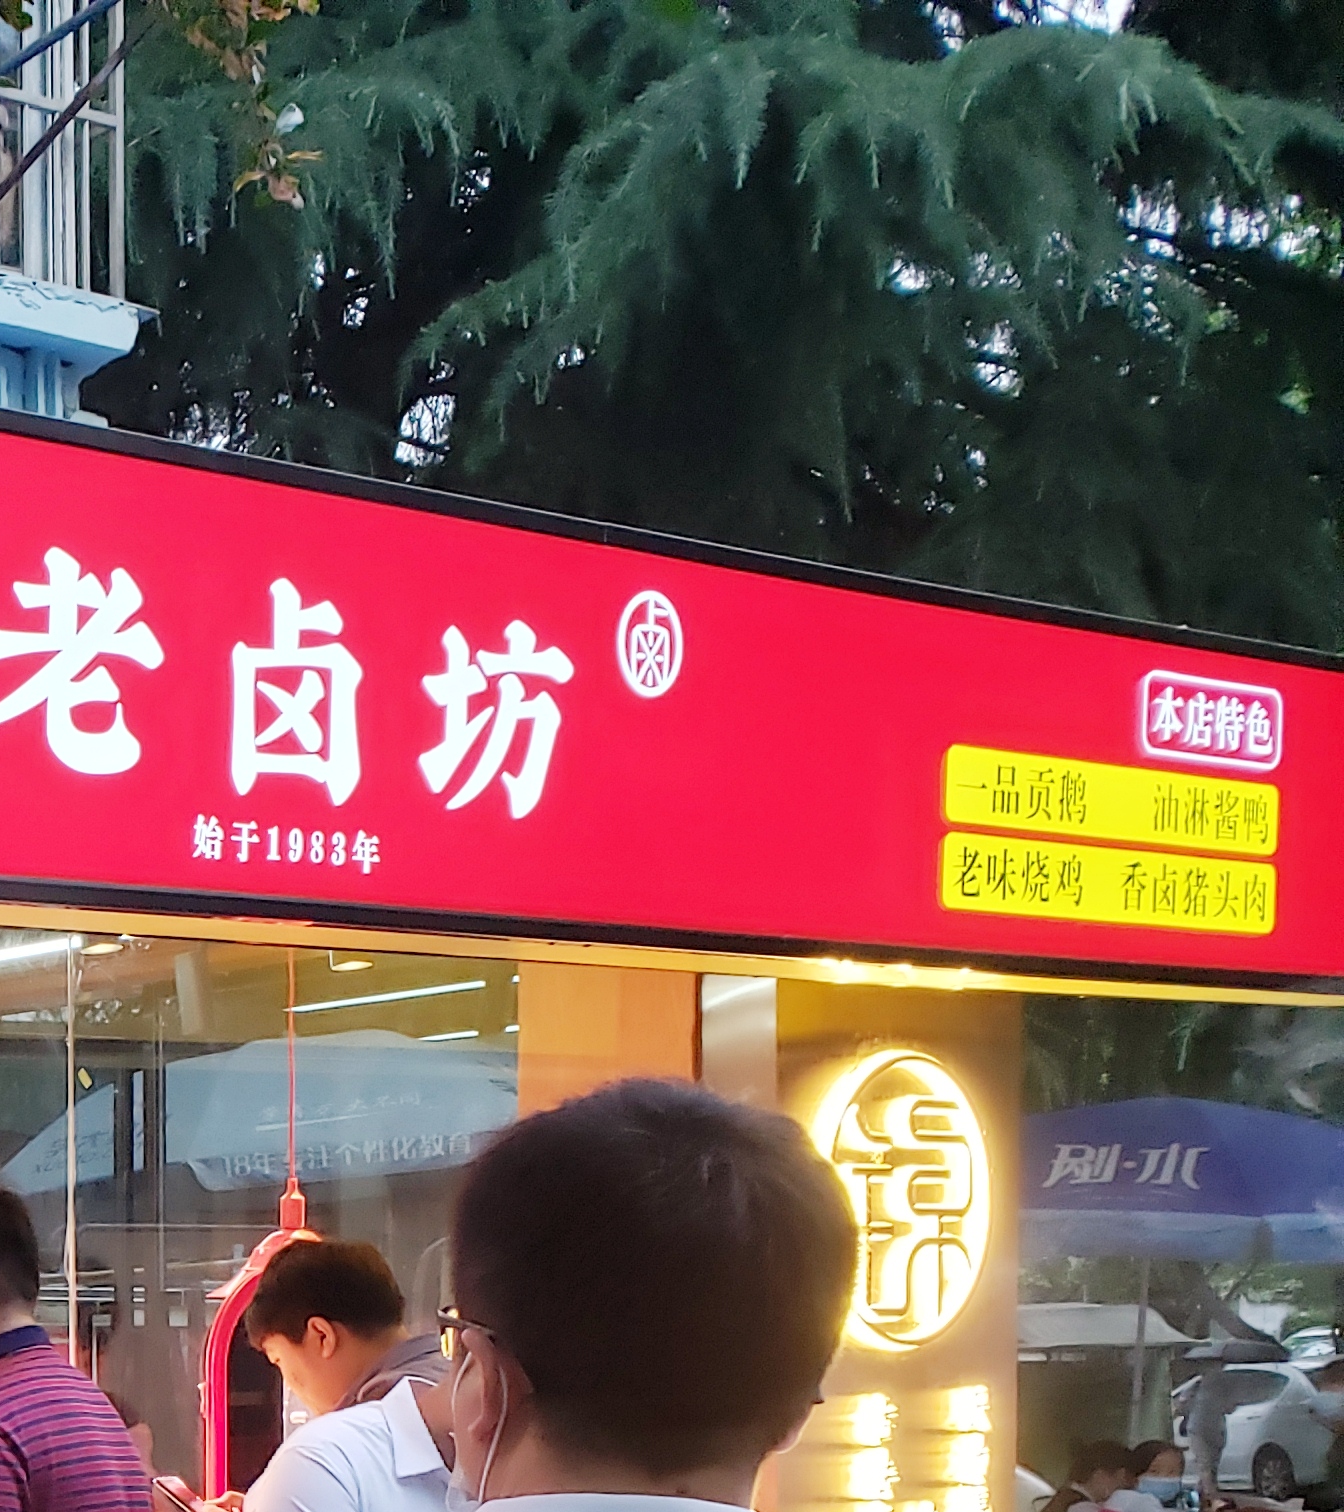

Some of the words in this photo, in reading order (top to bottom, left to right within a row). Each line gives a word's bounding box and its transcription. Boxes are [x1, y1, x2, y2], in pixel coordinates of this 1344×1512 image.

[1152, 685, 1273, 755] 本店特色
[955, 764, 1088, 825] 一品贡鹅
[1153, 782, 1270, 845] 油淋酱鸭
[192, 813, 381, 875] 始于1983年
[952, 846, 1084, 907] 老味烧鸡
[1119, 860, 1268, 923] 香卤猪头肉
